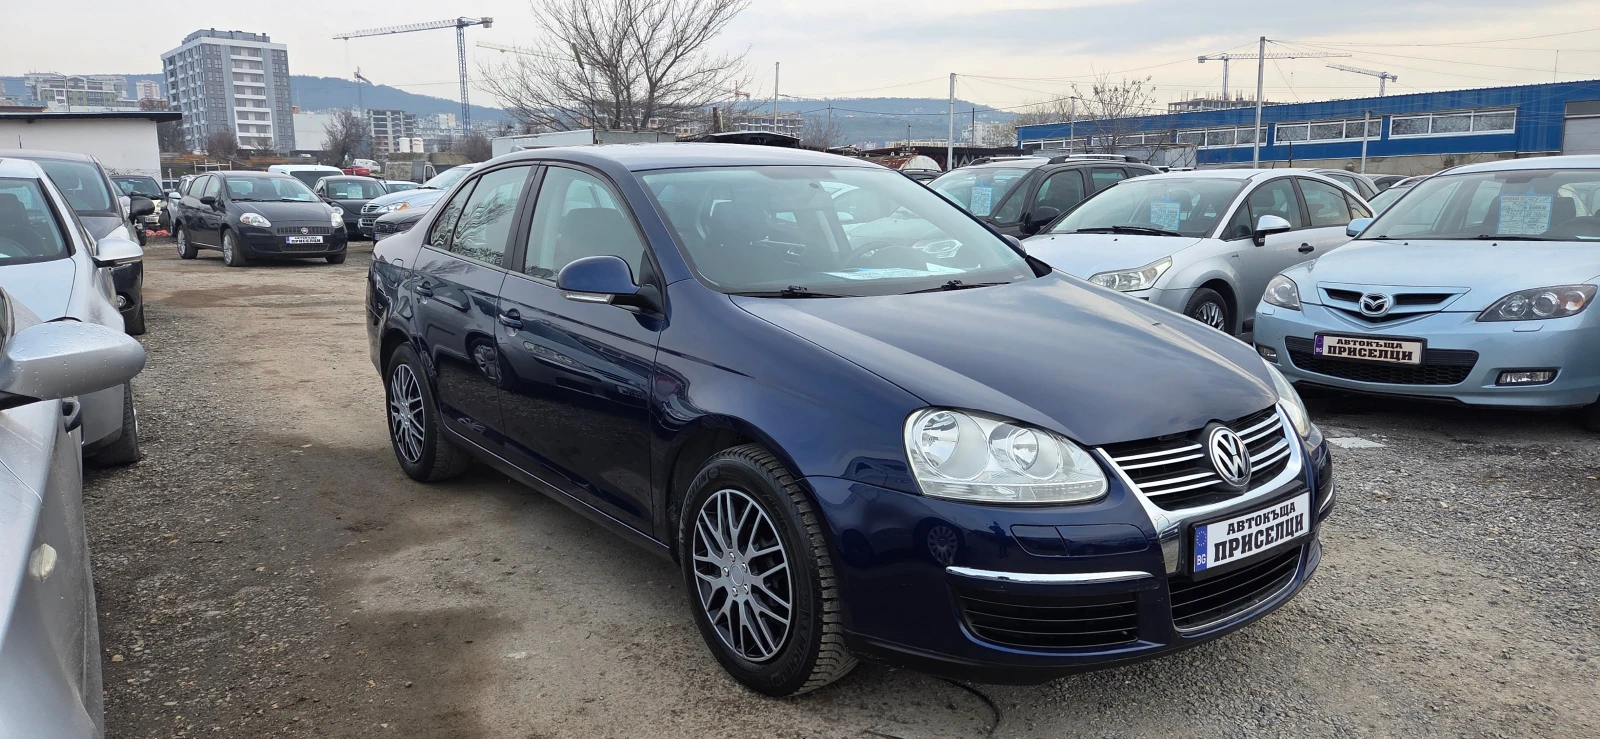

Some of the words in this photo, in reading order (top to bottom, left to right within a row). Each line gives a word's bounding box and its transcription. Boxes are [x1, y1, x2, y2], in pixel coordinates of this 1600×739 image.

[1336, 338, 1403, 350] АВТОКЪЩА
[1327, 345, 1414, 361] ПРИСЕЛЦИ
[1226, 501, 1296, 536] АВТОКЪЩА
[1213, 512, 1304, 563] ПРИСЕЛЦИ
[1196, 553, 1207, 566] BG
